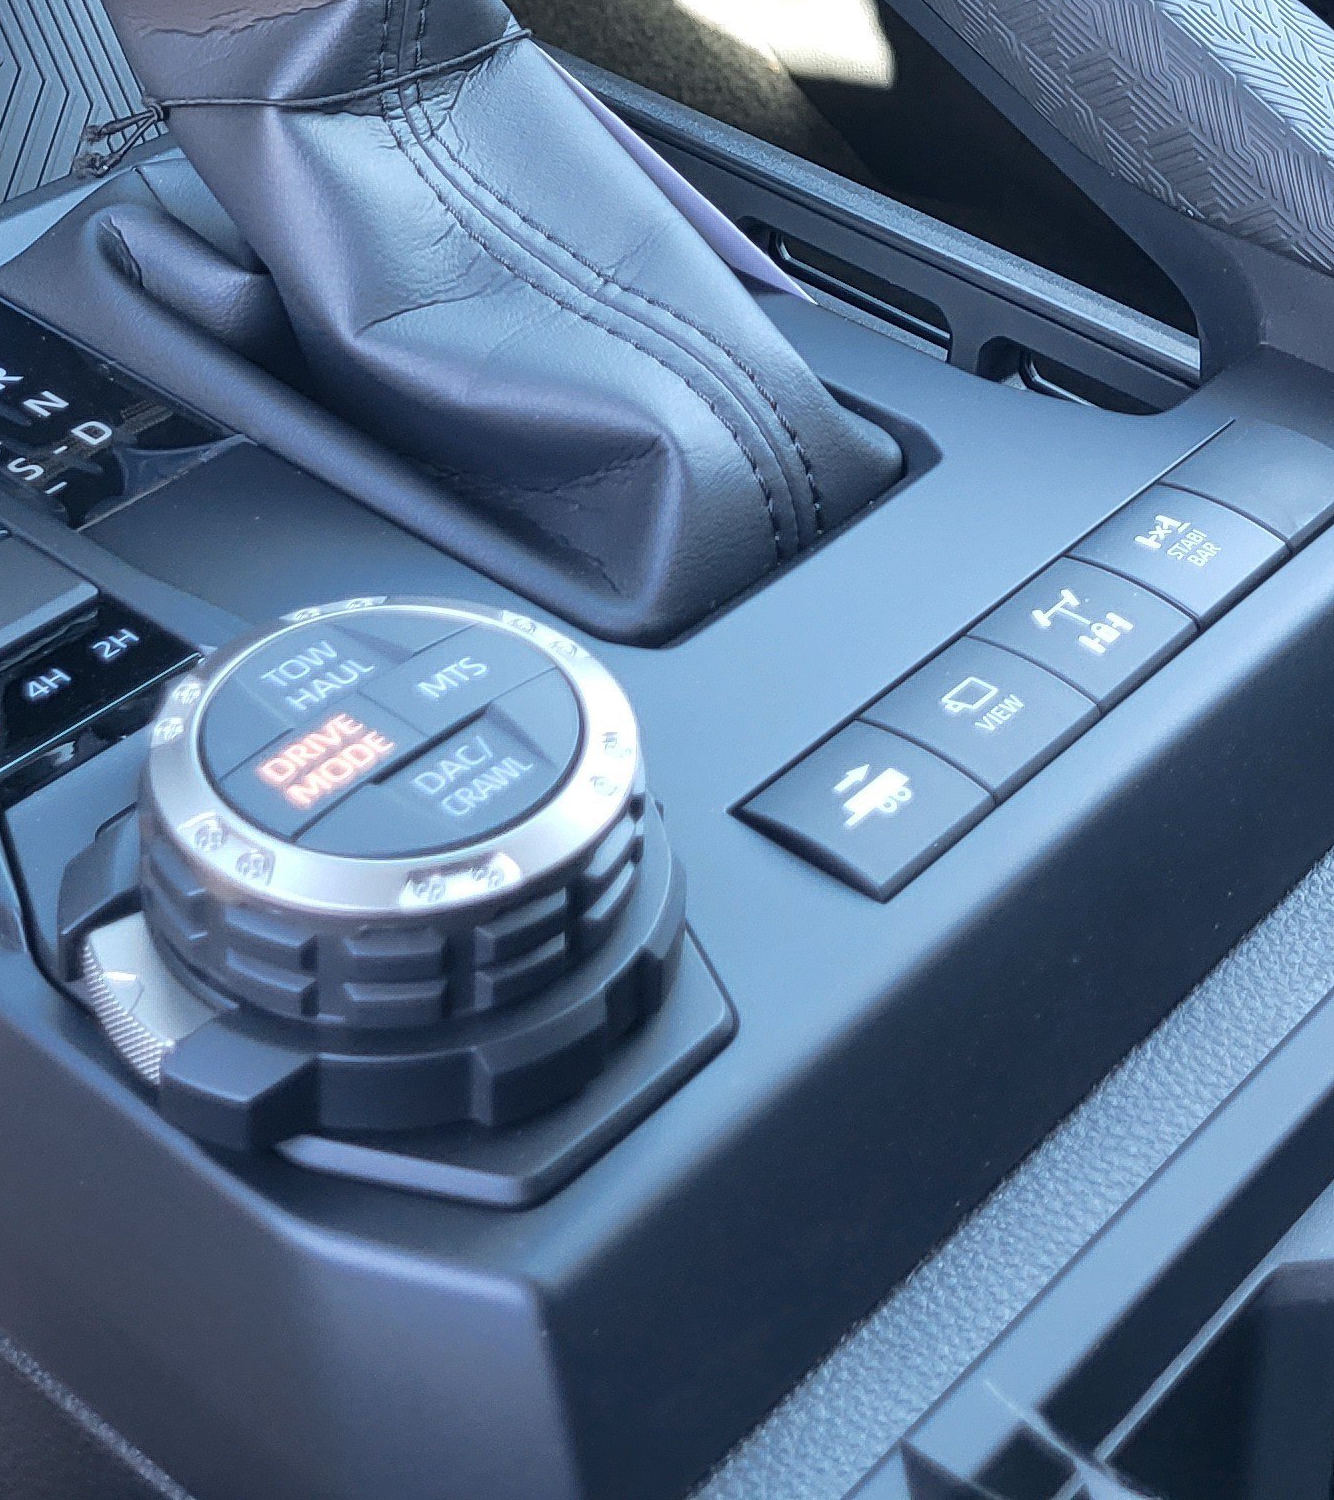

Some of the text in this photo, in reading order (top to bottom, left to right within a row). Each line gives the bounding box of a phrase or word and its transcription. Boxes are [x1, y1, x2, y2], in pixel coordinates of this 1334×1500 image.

[24, 390, 70, 418] N
[71, 419, 114, 446] D
[7, 457, 45, 482] S
[1166, 528, 1208, 561] STABI
[1186, 541, 1222, 567] BAR
[25, 668, 72, 700] 4H
[93, 627, 140, 661] 2H
[261, 640, 339, 689] TOW
[284, 658, 376, 712] HAUL
[417, 655, 488, 699] MTS
[974, 693, 1024, 733] VIEW
[258, 713, 365, 785] DRIVE
[286, 729, 395, 808] MODE
[413, 736, 494, 796] DAC/
[441, 757, 535, 817] CRAWL
